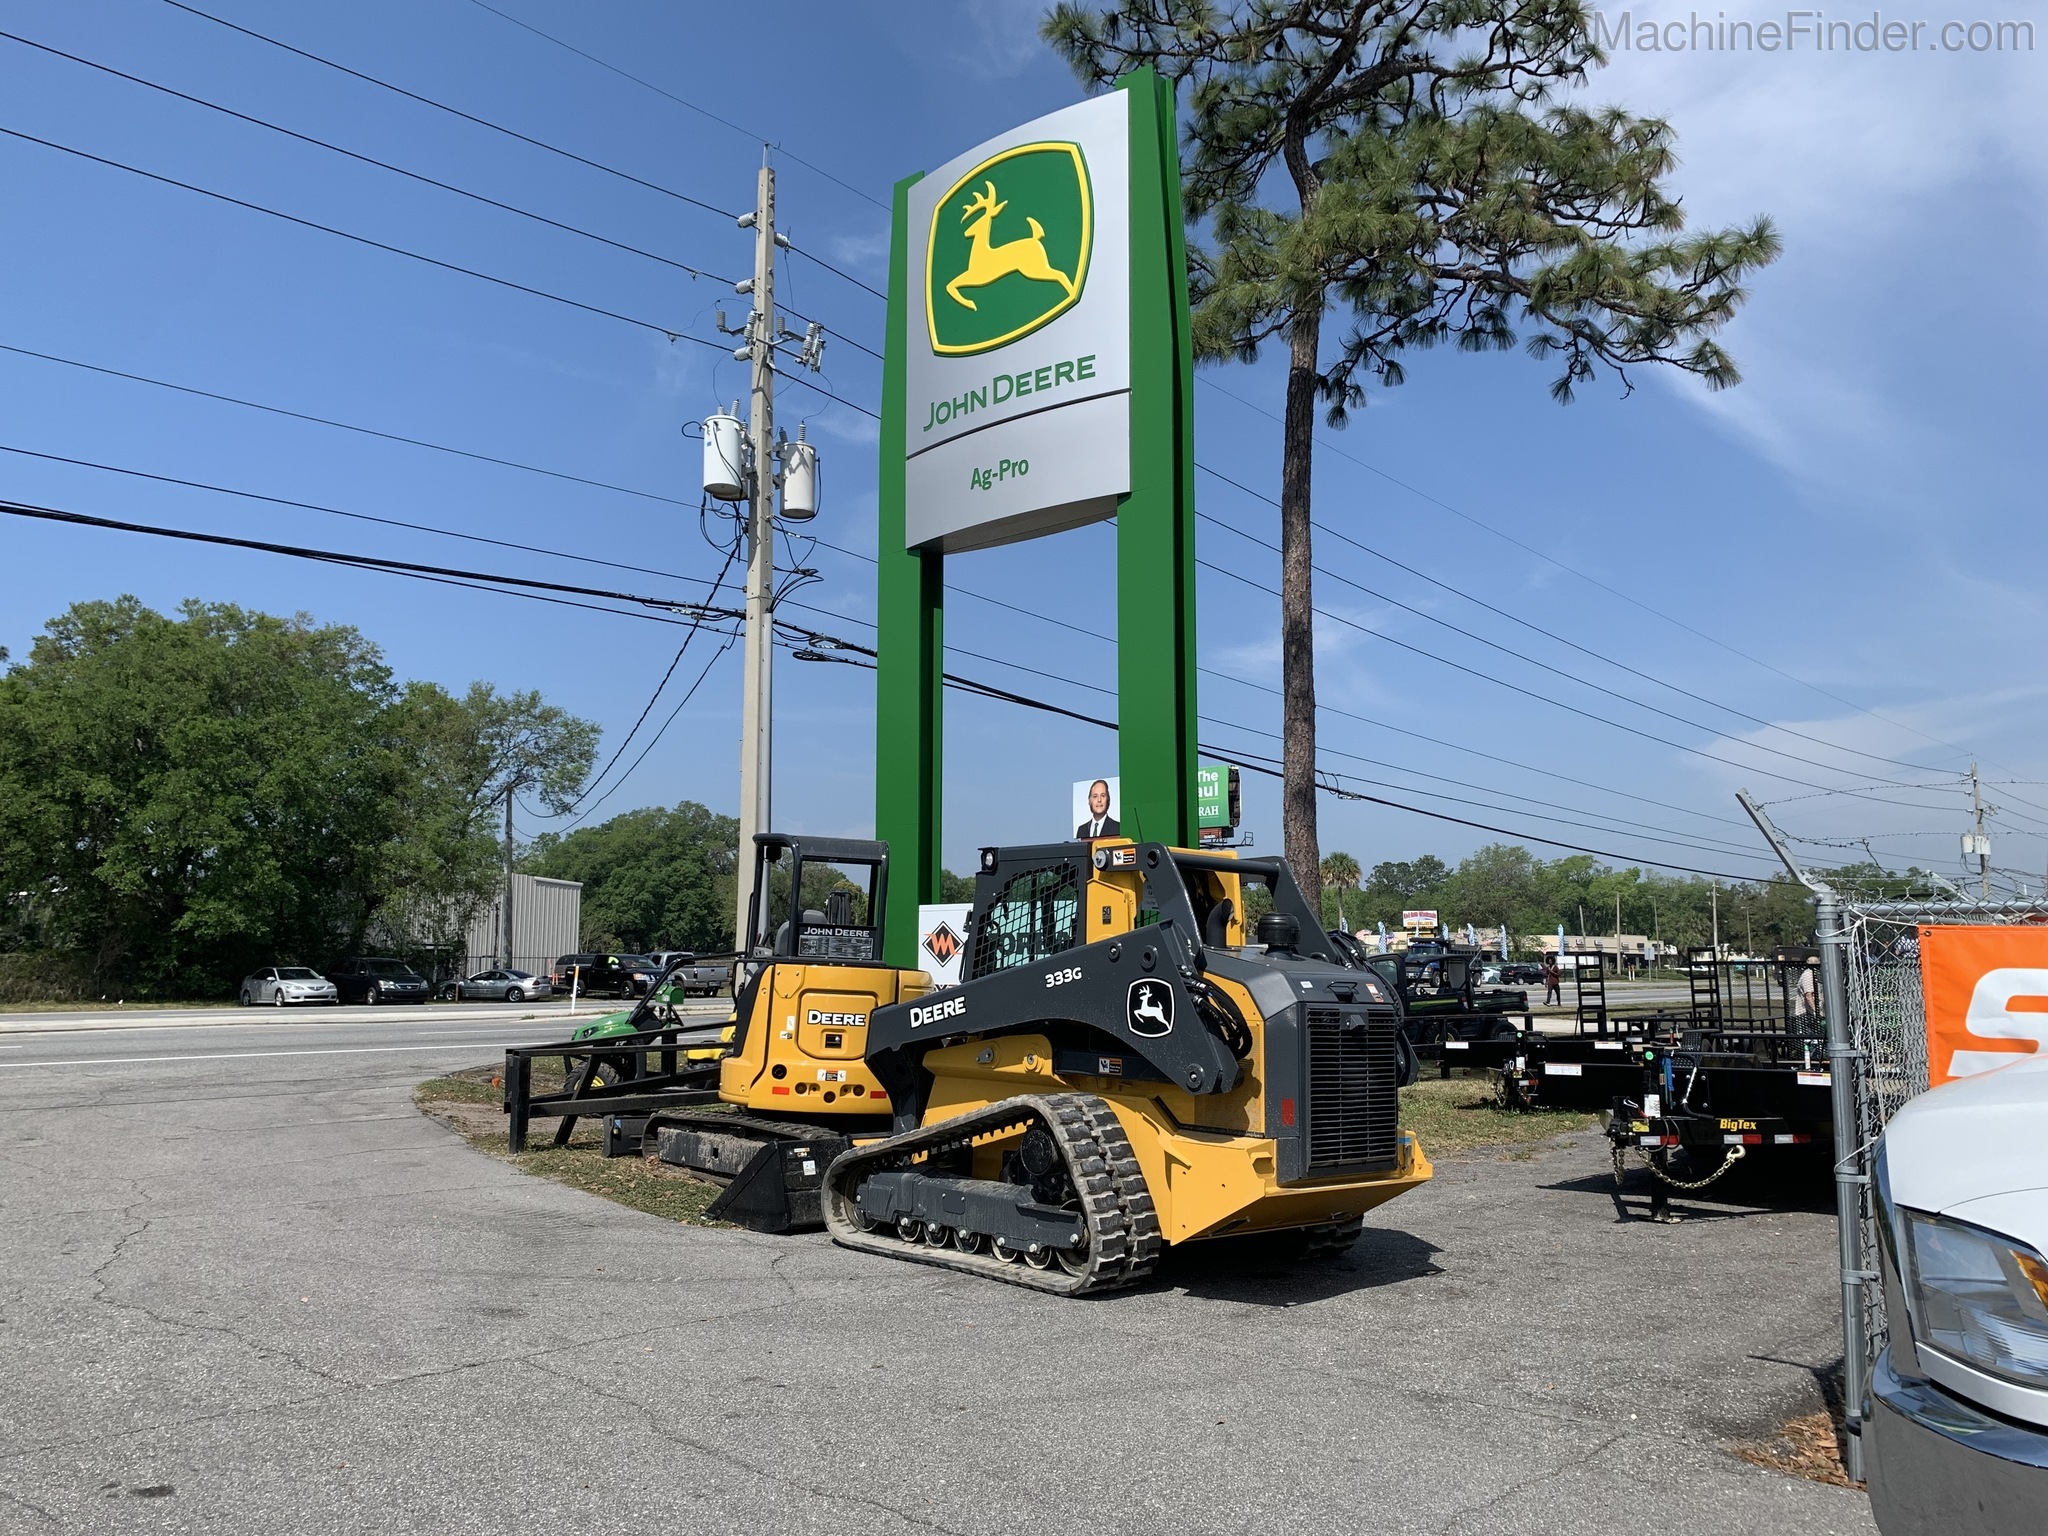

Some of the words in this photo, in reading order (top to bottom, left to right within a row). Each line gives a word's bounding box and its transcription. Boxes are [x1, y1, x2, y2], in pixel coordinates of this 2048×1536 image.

[923, 386, 987, 432] JOHN
[993, 354, 1096, 404] DEERE
[970, 459, 1029, 490] Ag-Pro
[804, 927, 833, 936] JOHN
[835, 928, 870, 937] DEERE
[1045, 967, 1082, 988] 333G
[808, 1010, 866, 1026] DEERE
[910, 996, 967, 1028] DEERE
